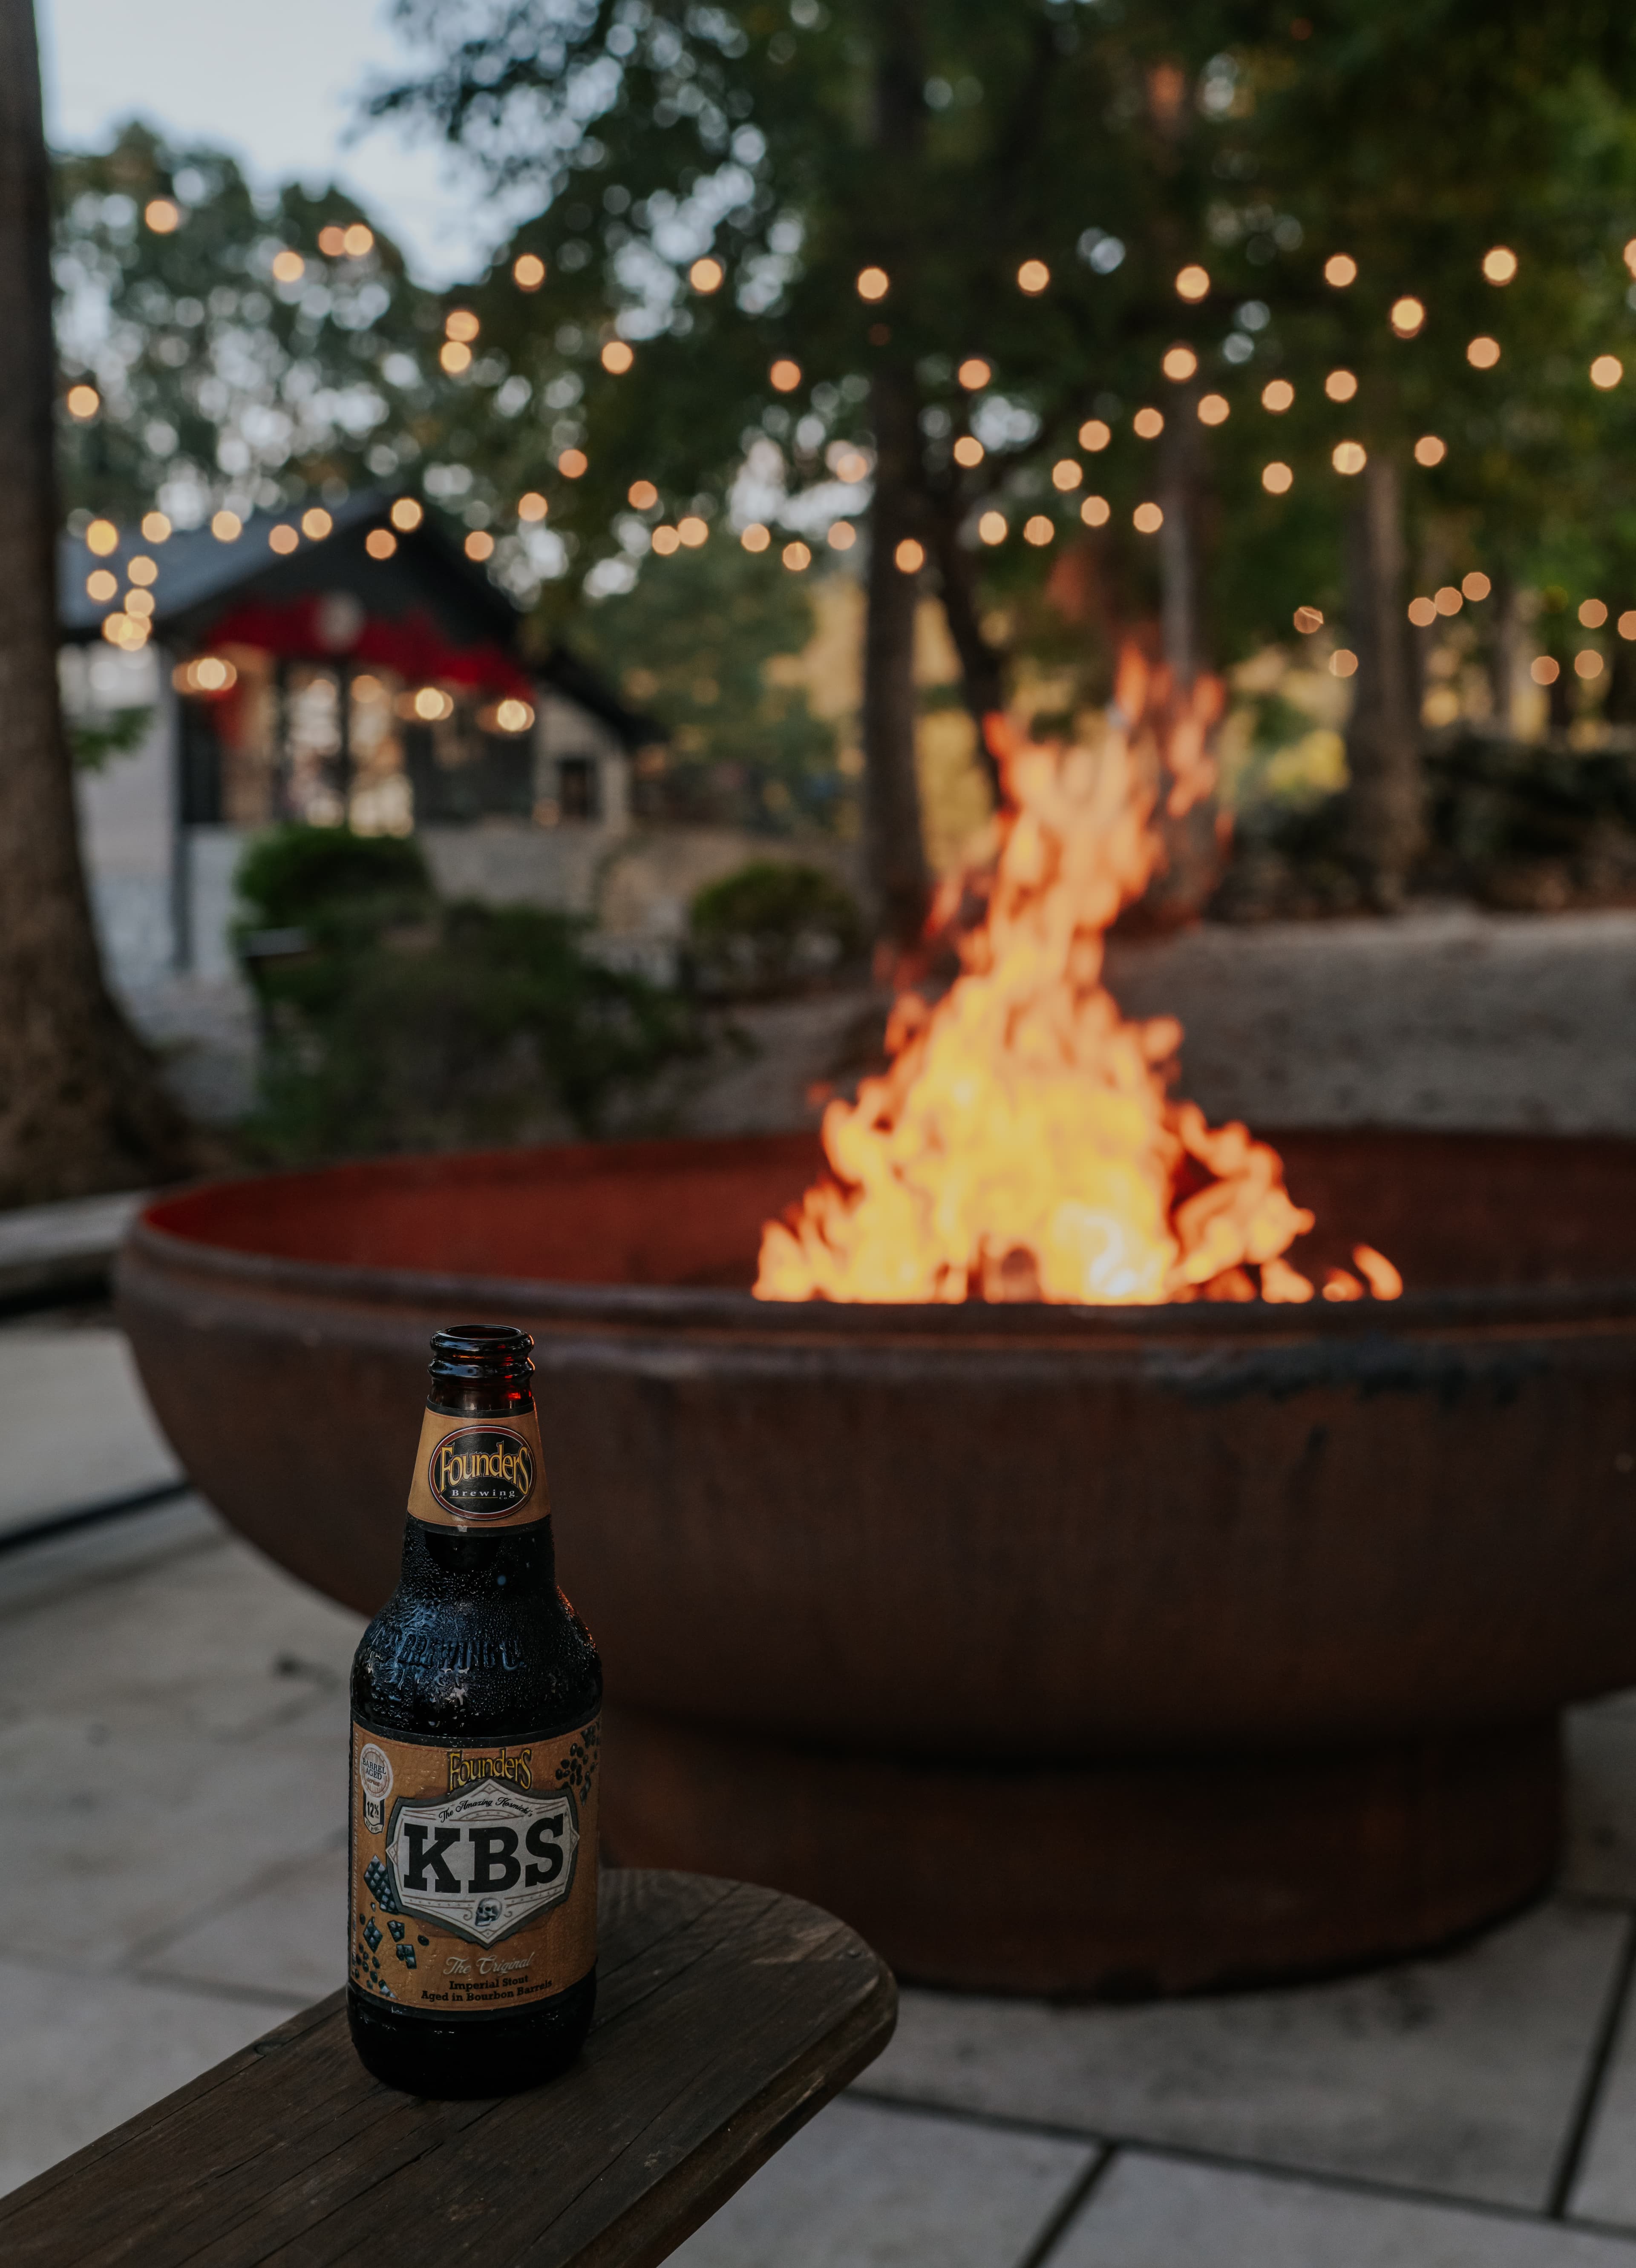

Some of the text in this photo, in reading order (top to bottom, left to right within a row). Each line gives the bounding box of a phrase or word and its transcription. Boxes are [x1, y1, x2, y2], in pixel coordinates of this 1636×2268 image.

[439, 1441, 529, 1496] Founders
[452, 1489, 515, 1498] Brewing
[363, 1758, 386, 1774] BARREL
[366, 1768, 382, 1780] AGED
[449, 1748, 532, 1792] Founders
[367, 1801, 379, 1818] 12%
[439, 1807, 454, 1822] The
[455, 1799, 493, 1812] Amazing
[403, 1814, 564, 1893] KBS
[443, 1952, 535, 1975] The Original
[421, 1979, 553, 2002] Aged in Bourbon Barrels
[449, 1975, 528, 1992] Imperial Stout
